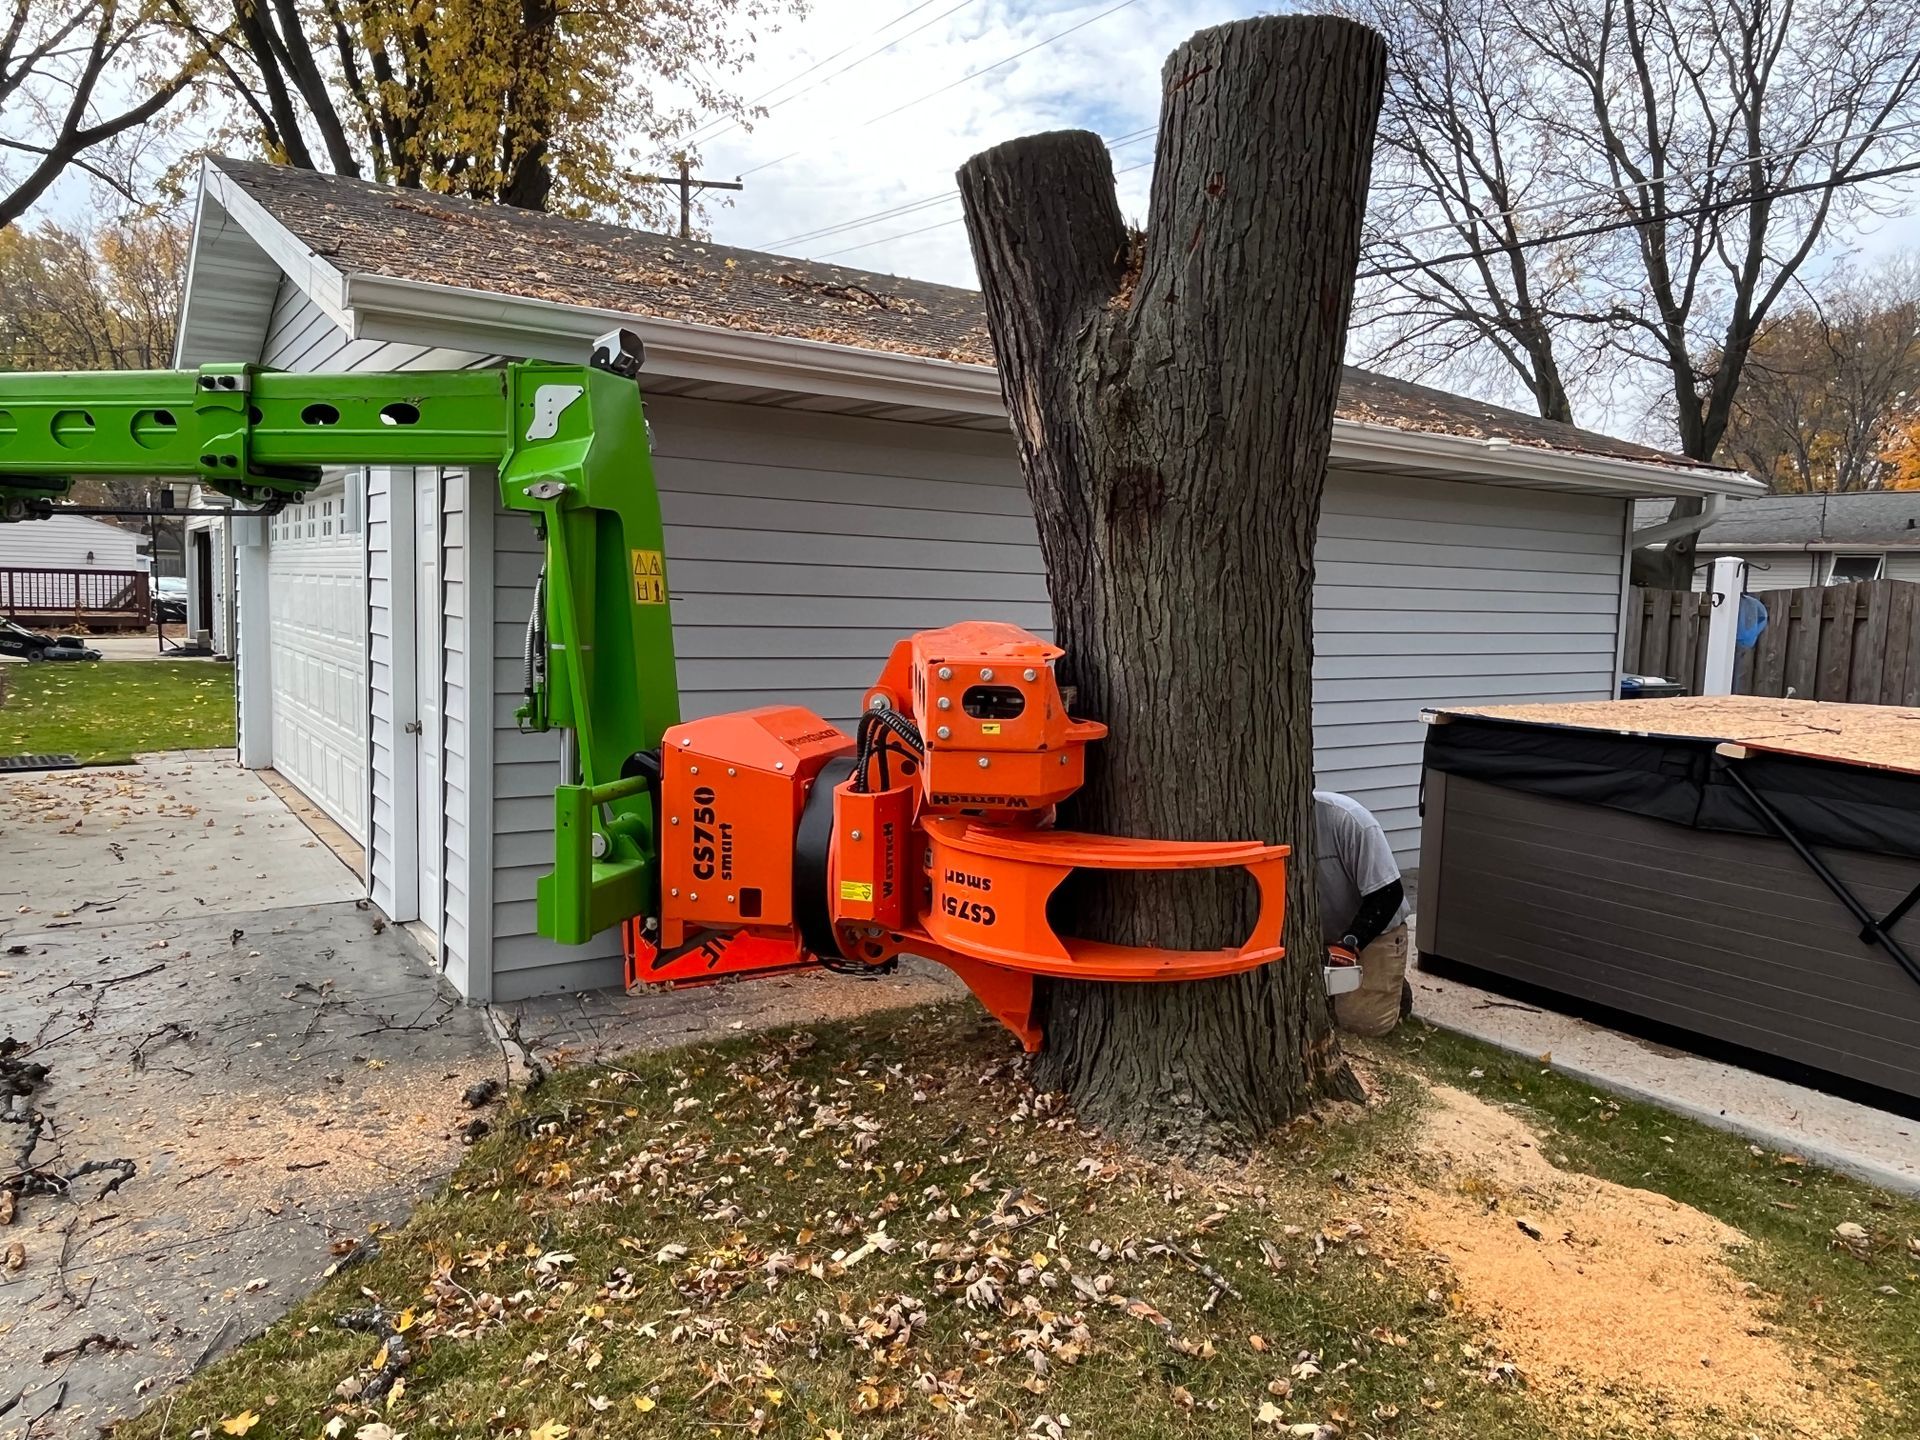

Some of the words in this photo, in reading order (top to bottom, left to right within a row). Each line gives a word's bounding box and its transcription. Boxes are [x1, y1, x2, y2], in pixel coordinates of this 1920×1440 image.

[0, 640, 23, 649] GO
[693, 787, 715, 880] CS750
[719, 823, 732, 880] smart
